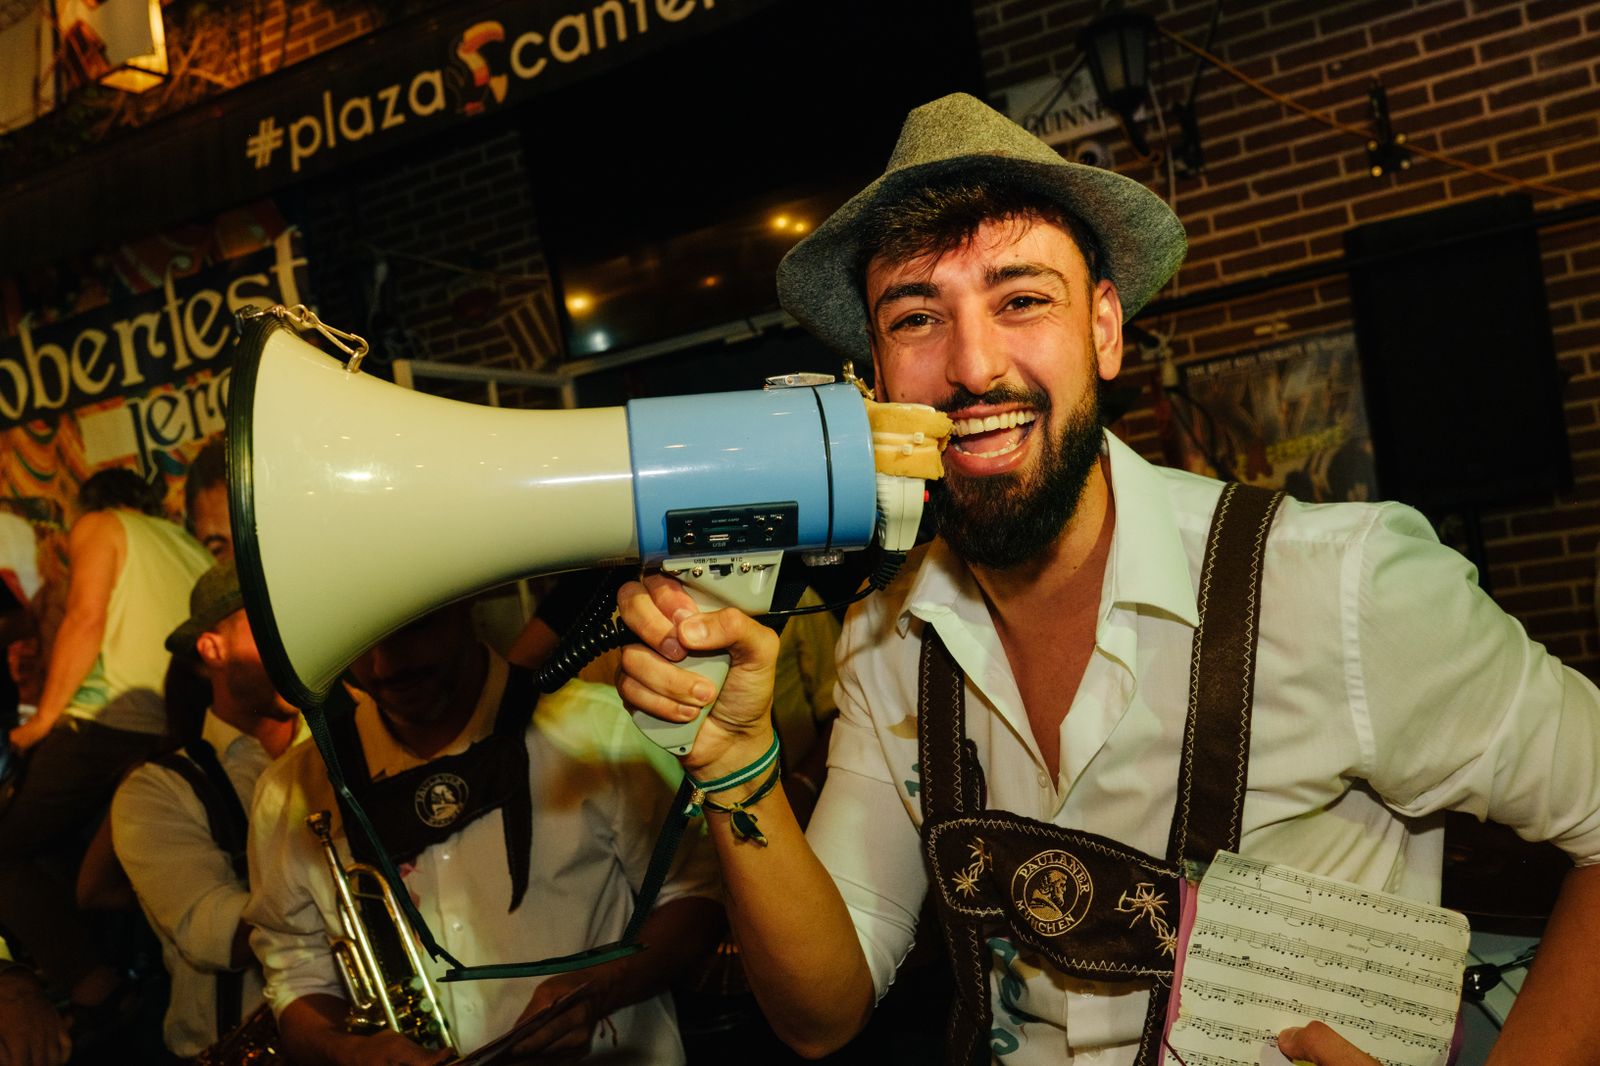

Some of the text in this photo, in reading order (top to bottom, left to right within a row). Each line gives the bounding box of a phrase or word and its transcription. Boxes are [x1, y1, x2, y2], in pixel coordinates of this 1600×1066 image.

[245, 0, 727, 171] #plaza cante
[1018, 852, 1091, 894] PAULANER
